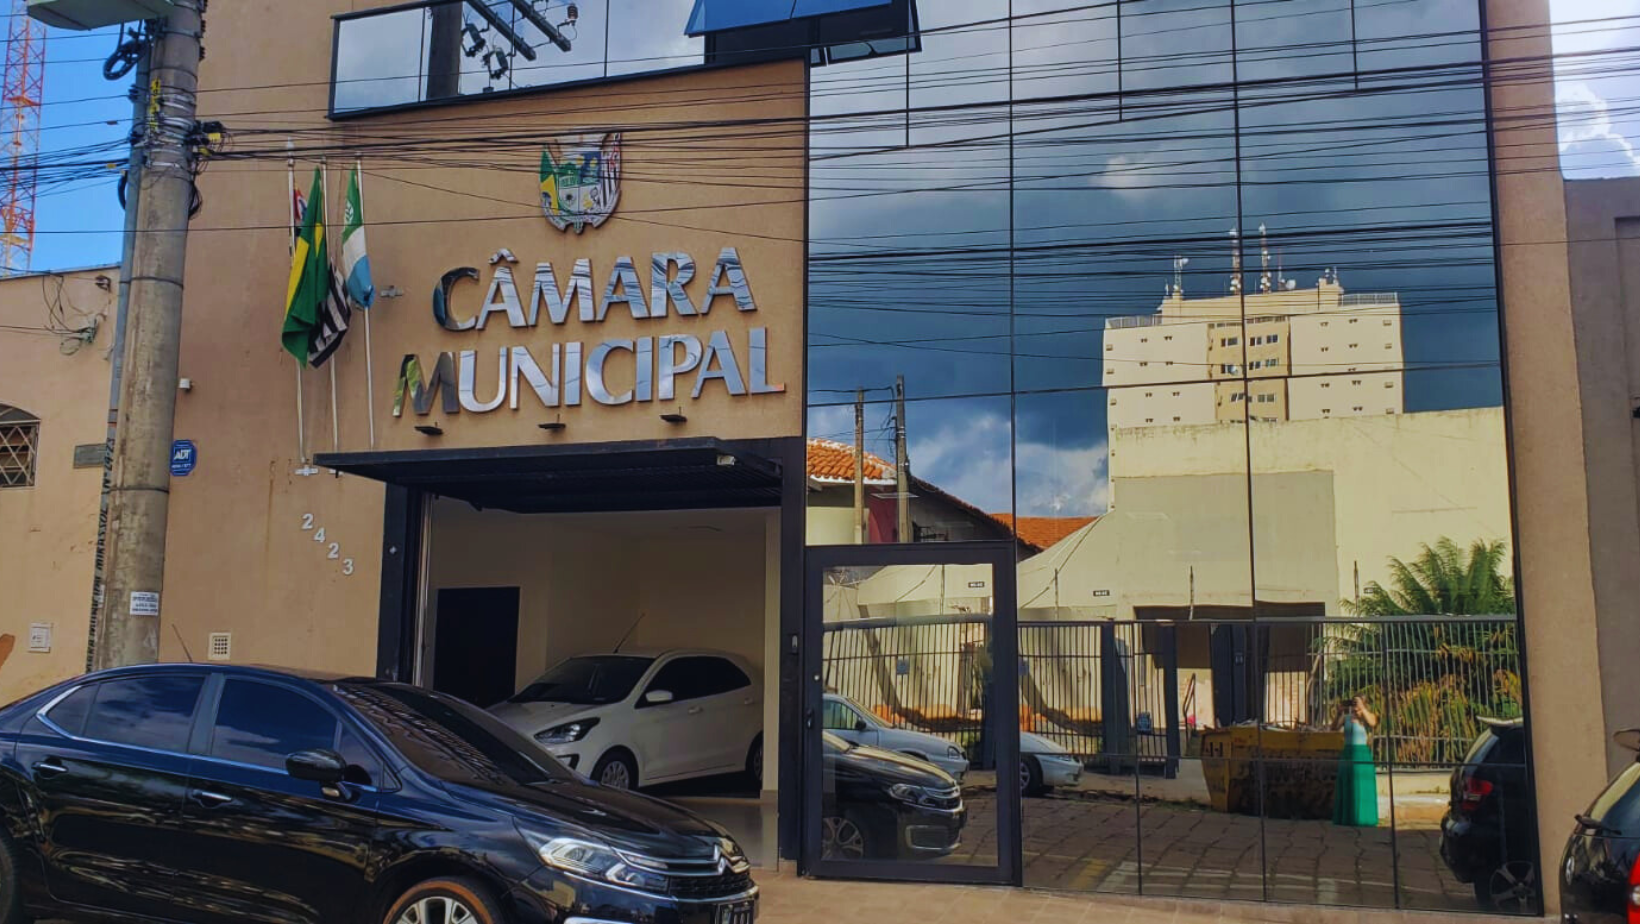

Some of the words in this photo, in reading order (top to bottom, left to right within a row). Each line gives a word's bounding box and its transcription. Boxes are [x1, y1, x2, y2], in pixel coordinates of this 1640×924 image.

[432, 247, 758, 332] CÂMARA
[392, 327, 786, 418] MUNICIPAL
[173, 448, 192, 460] ADT
[95, 508, 107, 571] MIRASSOL
